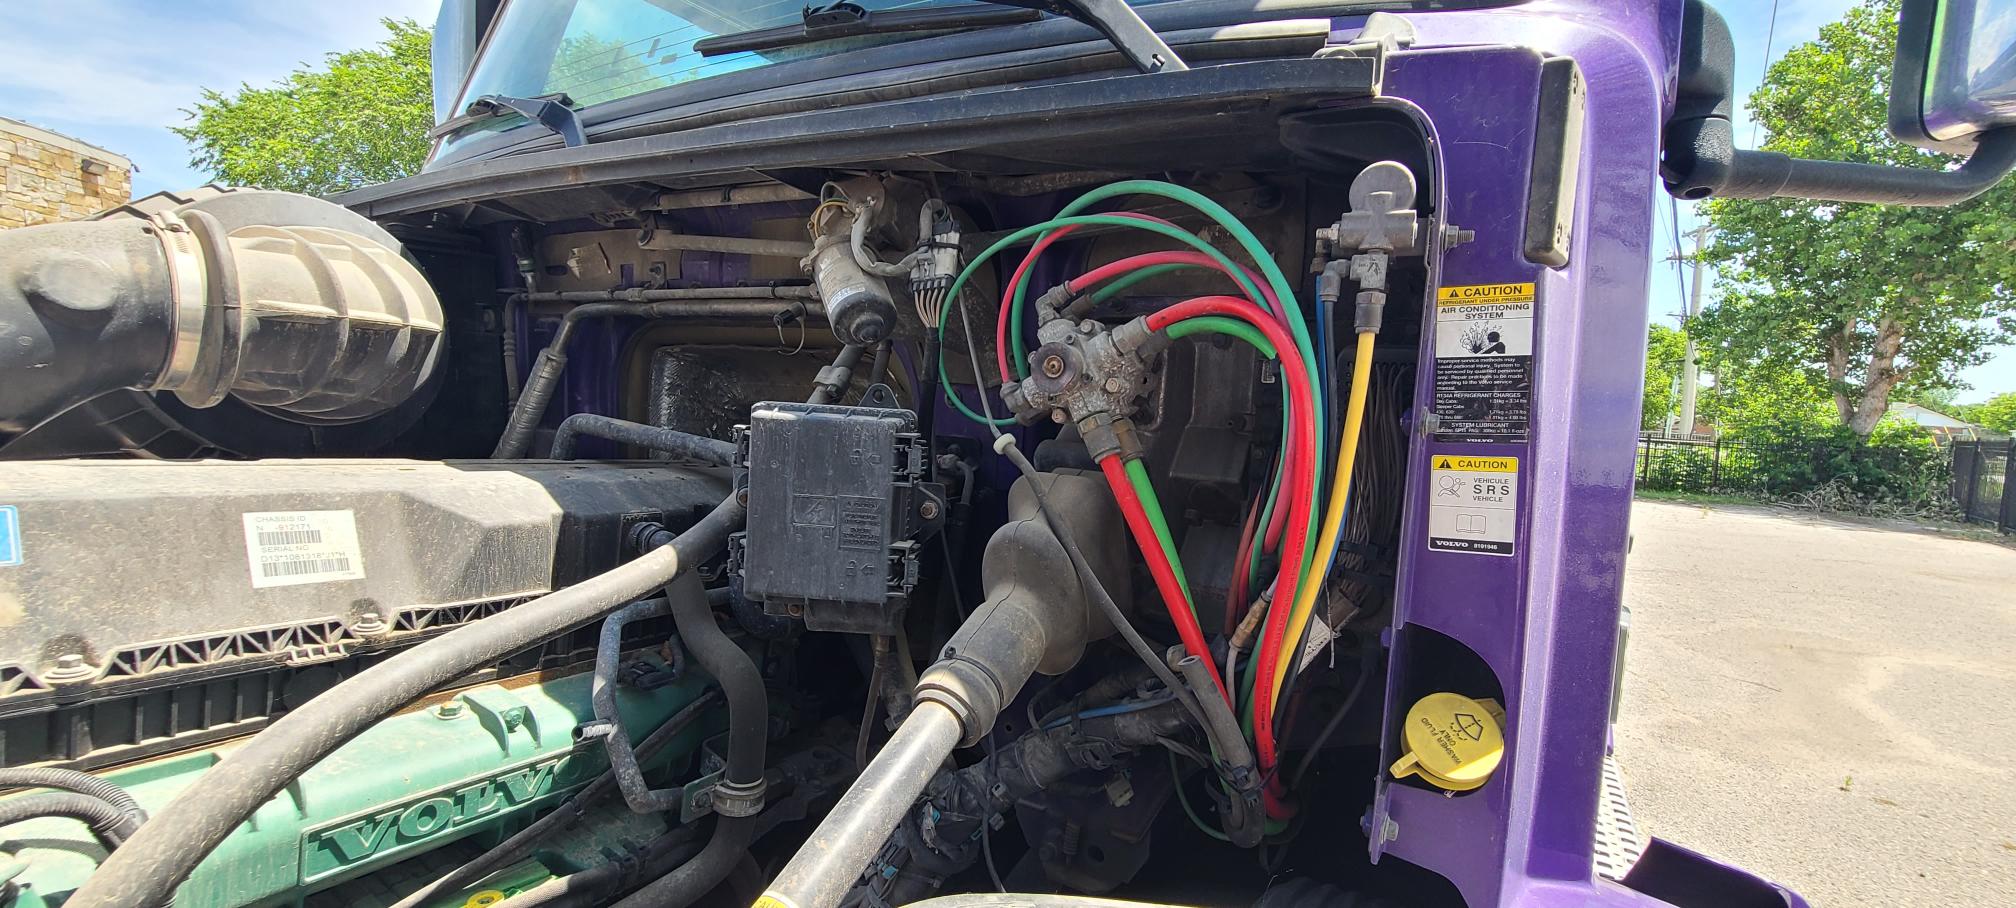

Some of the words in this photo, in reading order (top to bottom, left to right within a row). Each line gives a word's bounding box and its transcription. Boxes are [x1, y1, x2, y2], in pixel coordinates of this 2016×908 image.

[1463, 285, 1522, 297] CAUTION
[1458, 303, 1530, 313] CONDITIONING
[1465, 312, 1504, 320] SYSTEM
[1457, 460, 1508, 469] CAUTION
[1473, 477, 1509, 485] VEHICULE
[1472, 495, 1503, 503] VEHICLE
[255, 515, 295, 523] CHASSIS
[1435, 540, 1469, 548] VOLVO
[260, 545, 294, 553] SERIAL
[1421, 717, 1440, 736] FLUID
[1439, 729, 1457, 747] ONLY
[1437, 736, 1462, 765] WASHER
[320, 751, 594, 861] VOLVO
